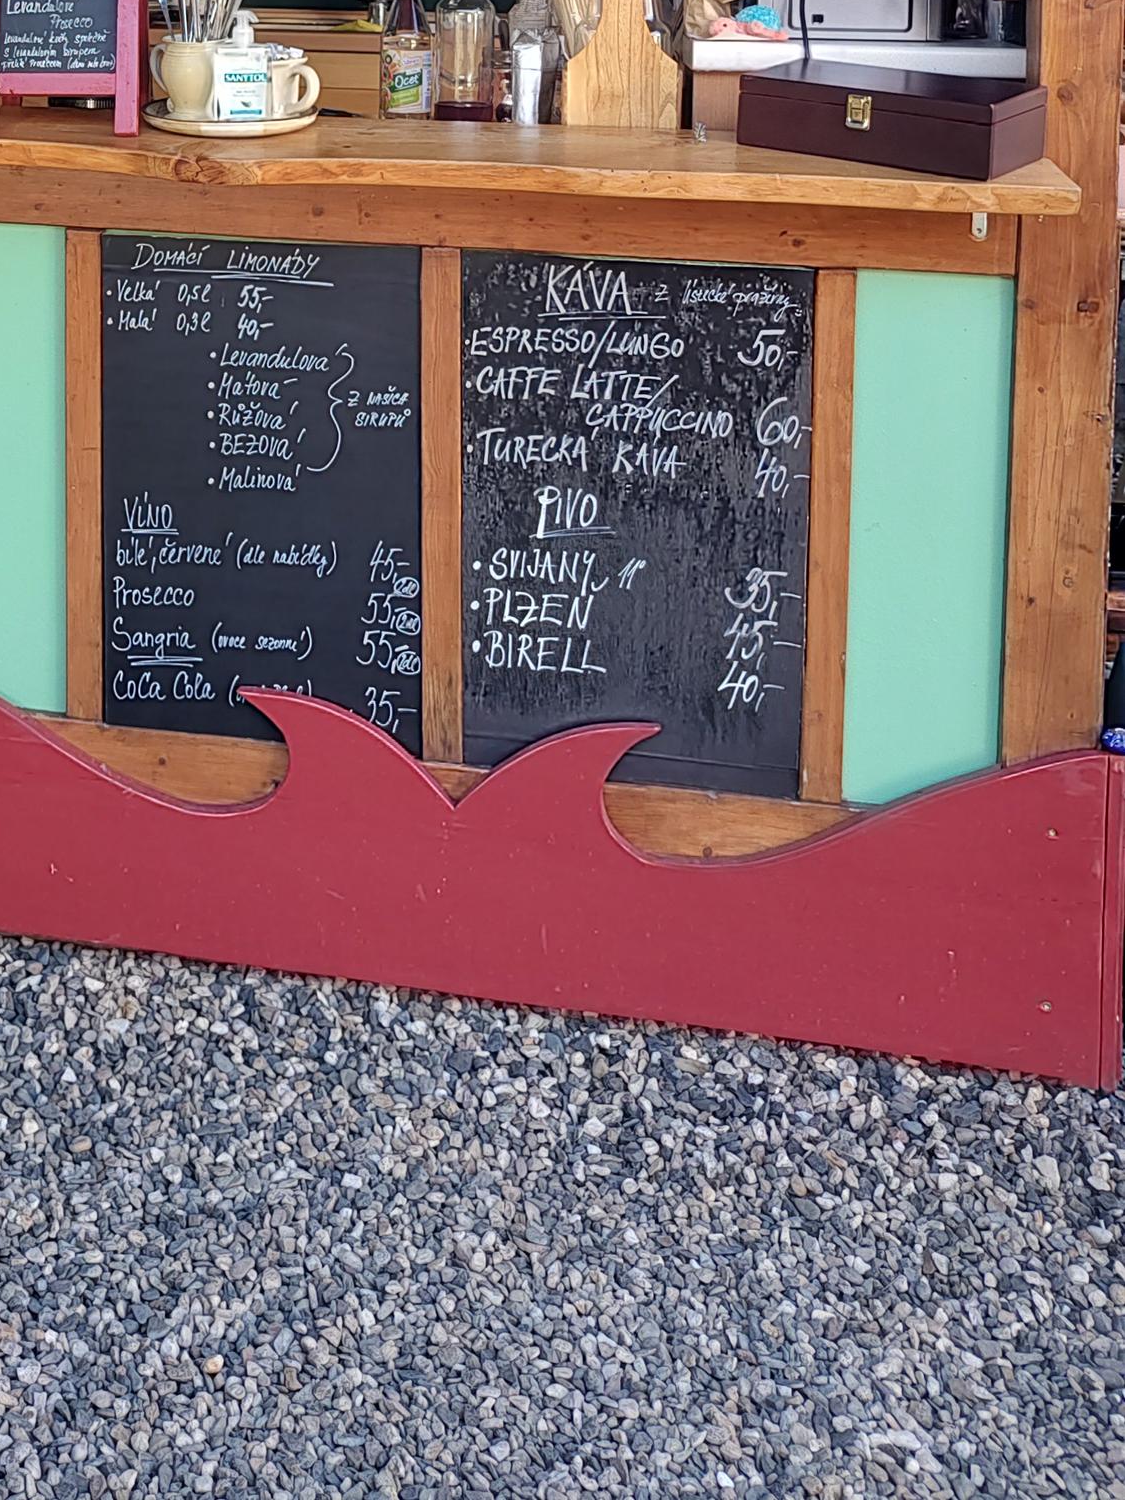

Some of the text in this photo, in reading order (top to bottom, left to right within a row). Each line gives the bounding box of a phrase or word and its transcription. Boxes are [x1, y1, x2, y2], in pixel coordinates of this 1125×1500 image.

[49, 14, 93, 29] Prosecco
[395, 74, 419, 88] Ocet
[116, 279, 160, 302] Velká
[545, 261, 632, 315] KÁVA
[118, 308, 157, 332] Malá
[219, 342, 348, 373] Levandulová
[476, 366, 560, 399] CAFFE
[218, 401, 299, 430] Růžová
[586, 403, 733, 437] CAPPUCCINO
[219, 463, 301, 492] Malinová
[123, 492, 173, 529] VÍNO
[535, 486, 597, 538] PIVO
[489, 548, 595, 596] SVIJANY
[112, 576, 195, 609] Prosecco
[111, 616, 197, 659] Sangria
[484, 630, 606, 673] BIRELL
[173, 671, 216, 700] Cola
